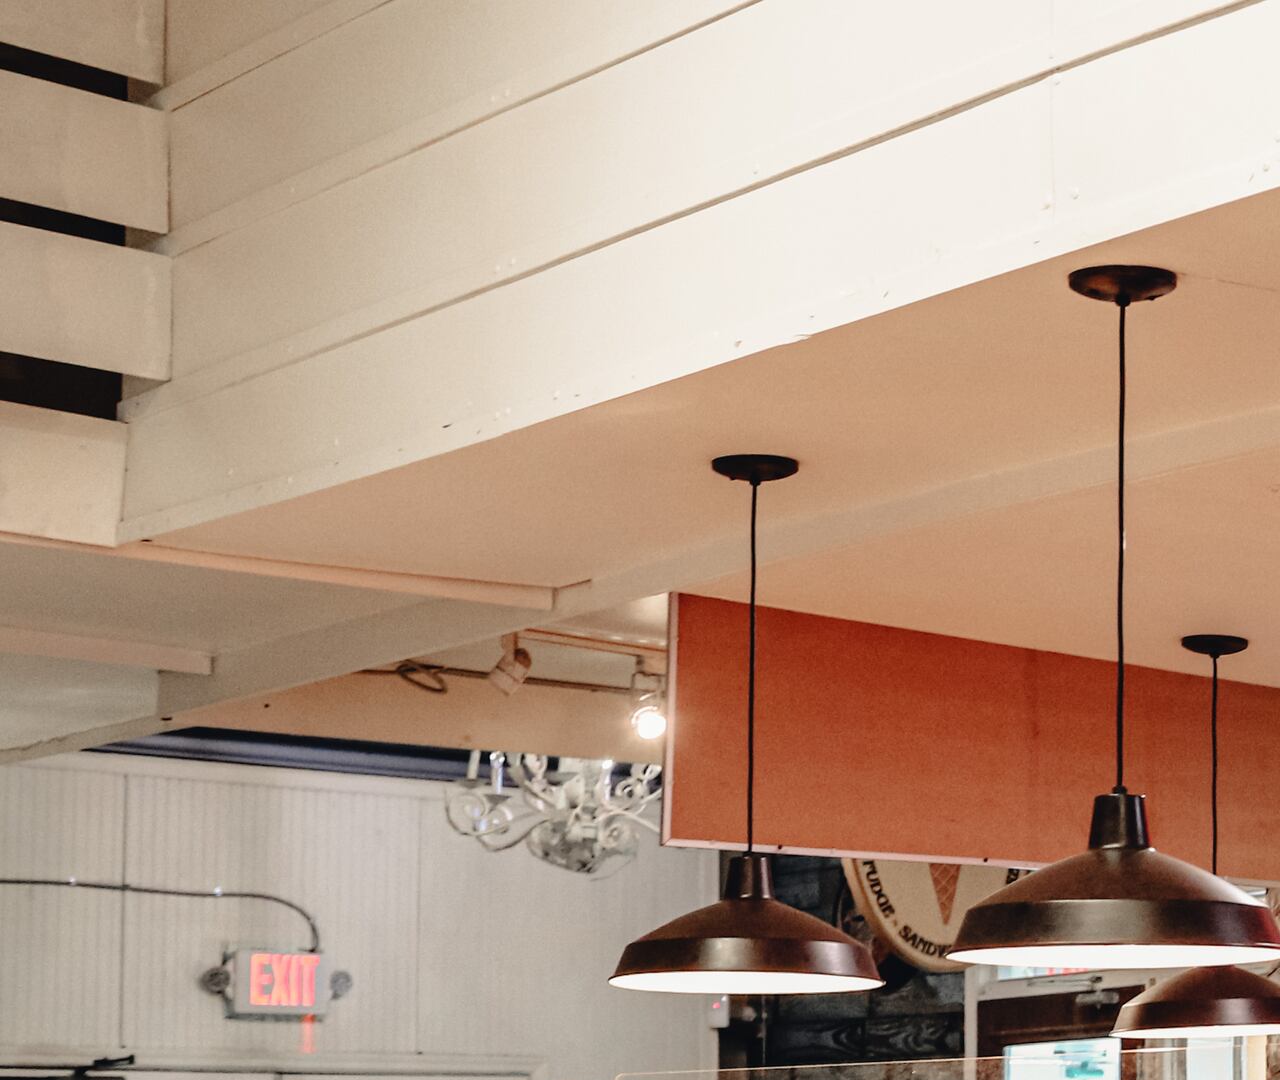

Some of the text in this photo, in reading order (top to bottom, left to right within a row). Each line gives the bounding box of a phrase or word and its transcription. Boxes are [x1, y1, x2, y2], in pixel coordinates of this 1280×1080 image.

[862, 859, 896, 919] FUDGE
[898, 924, 953, 959] SANDW
[249, 953, 321, 1007] EXIT
